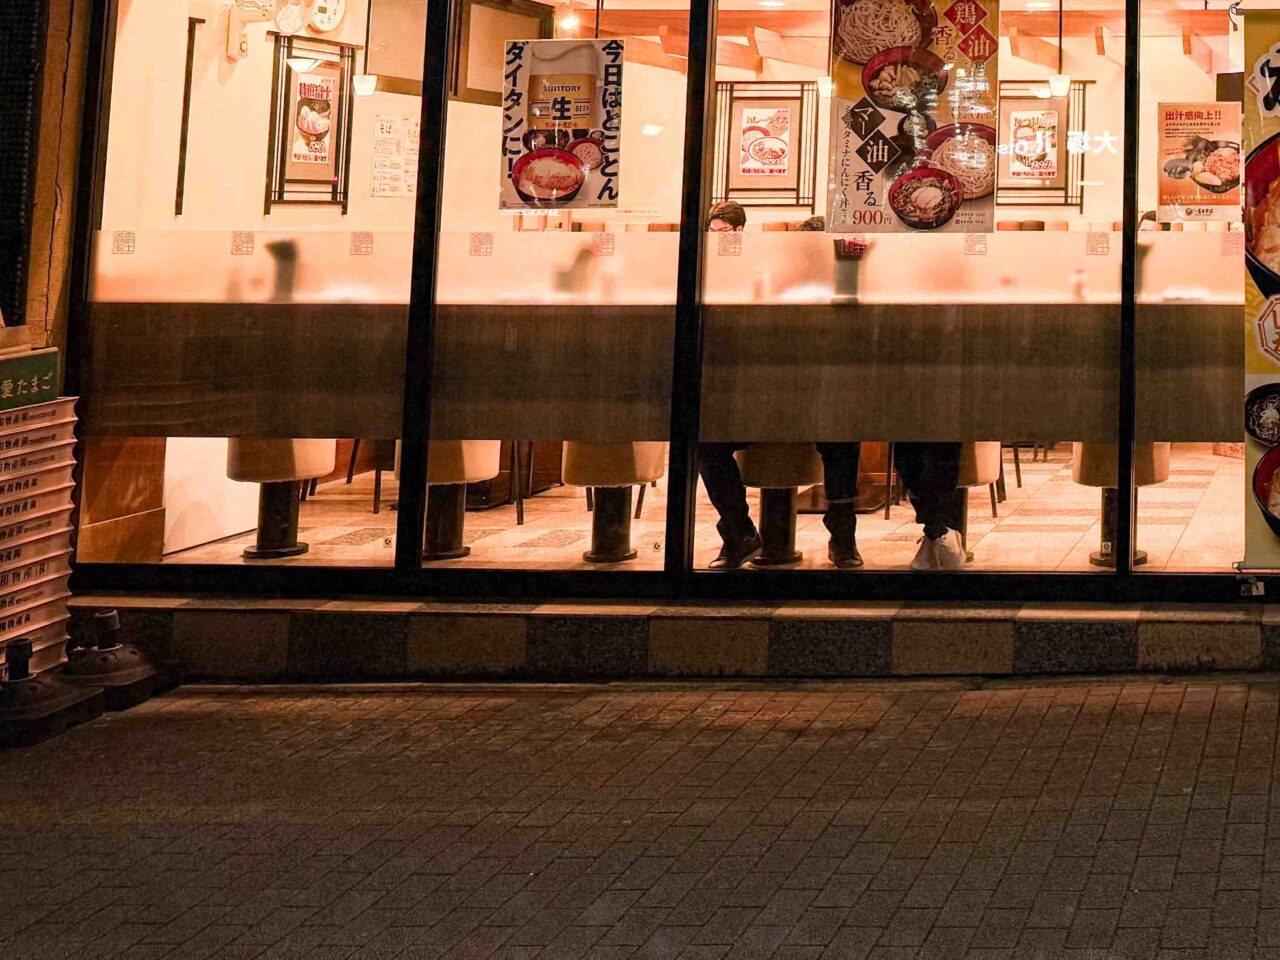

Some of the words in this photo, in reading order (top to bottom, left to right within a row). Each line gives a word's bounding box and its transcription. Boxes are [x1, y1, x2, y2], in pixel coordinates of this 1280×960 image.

[552, 96, 572, 120] 生
[597, 40, 625, 201] 今日はとことん
[853, 210, 892, 225] 900円
